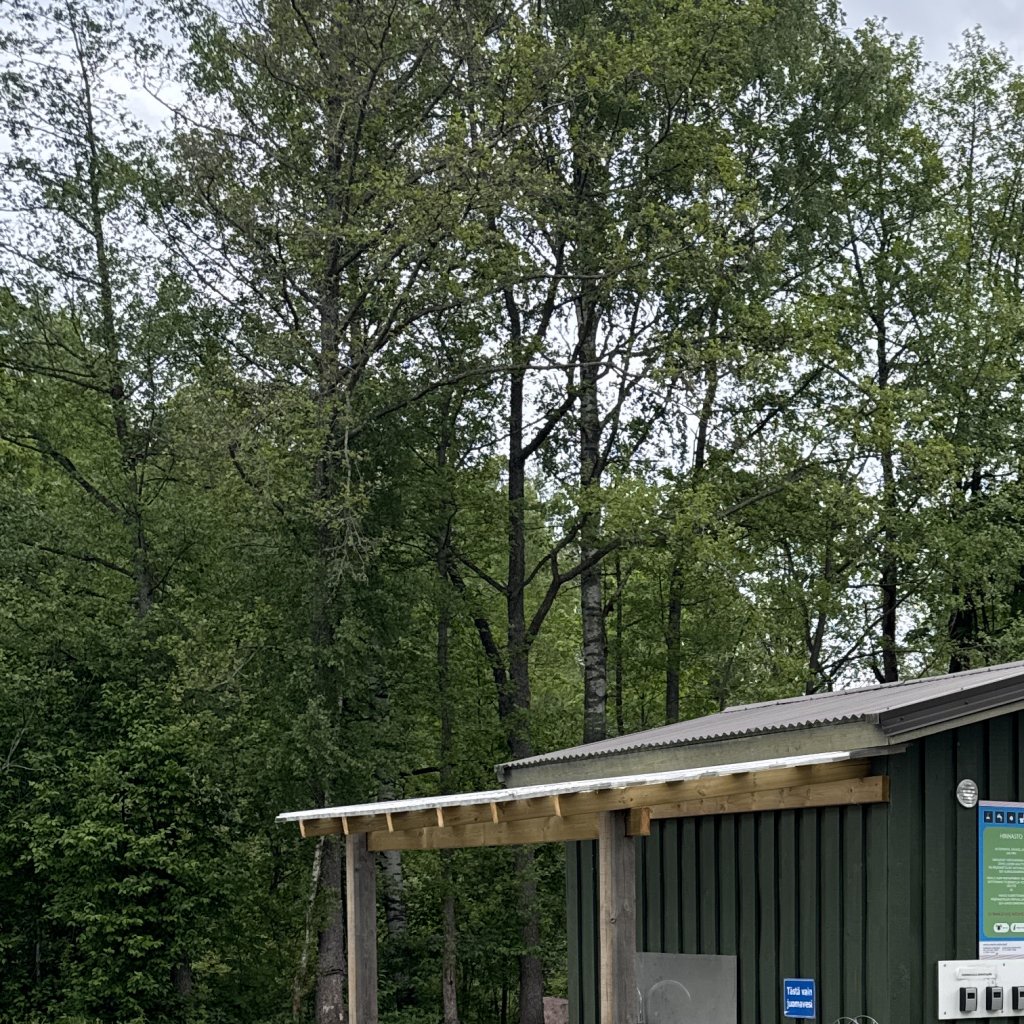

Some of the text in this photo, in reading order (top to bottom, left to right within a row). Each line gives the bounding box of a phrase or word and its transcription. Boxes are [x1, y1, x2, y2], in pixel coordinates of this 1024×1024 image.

[1000, 832, 1023, 840] HINNASTO
[787, 986, 812, 996] Tästä vain
[787, 998, 813, 1010] juomavesi
